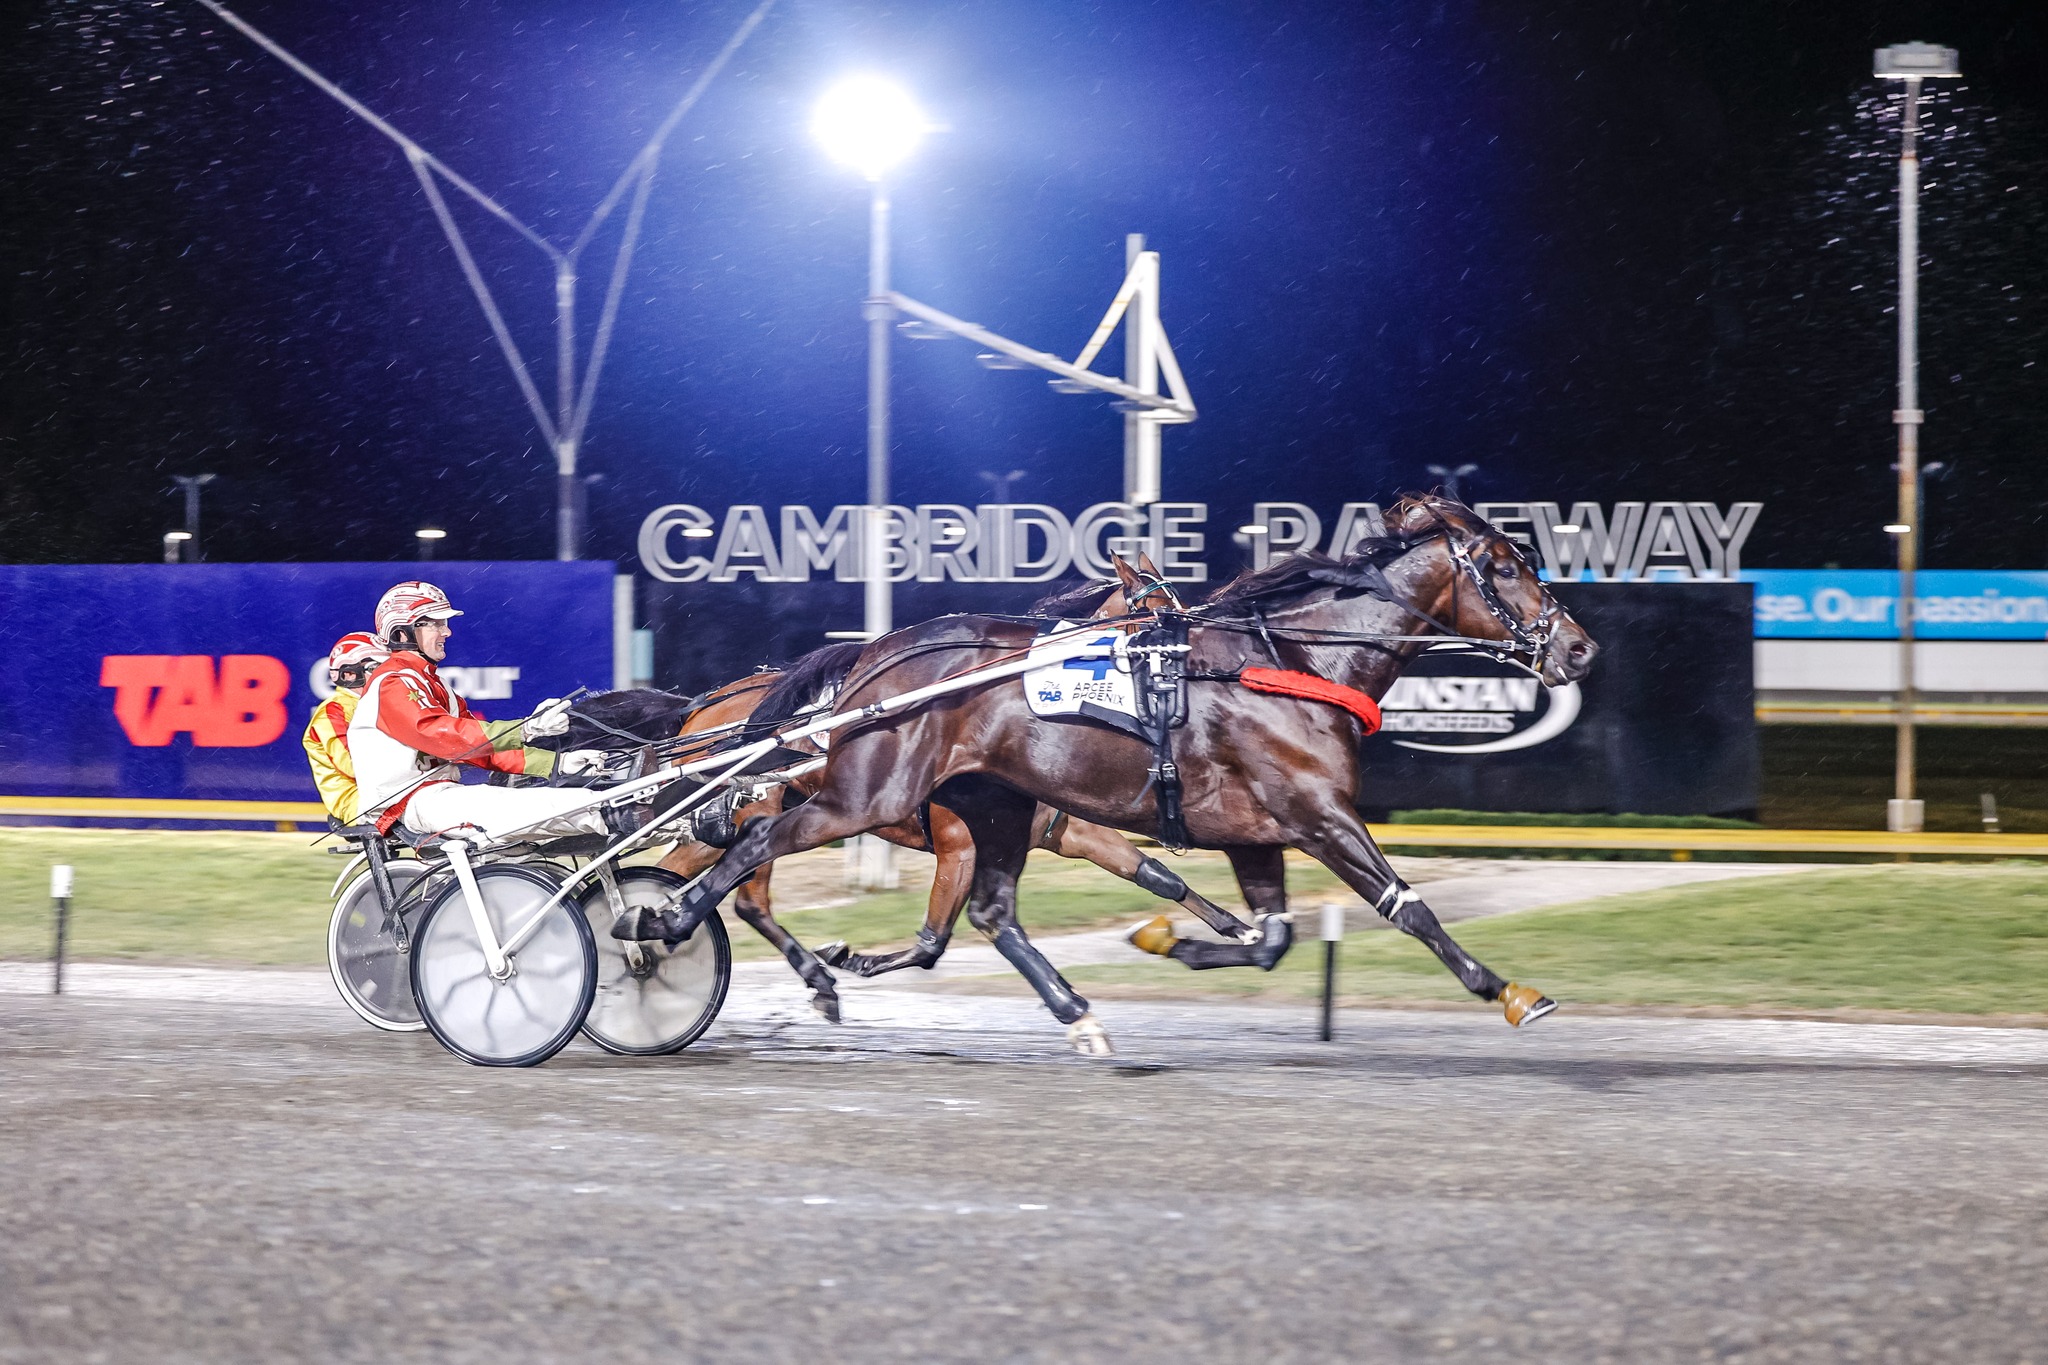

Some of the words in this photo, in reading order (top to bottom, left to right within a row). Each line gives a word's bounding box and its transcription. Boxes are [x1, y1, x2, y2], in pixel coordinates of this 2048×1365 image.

[637, 502, 1208, 584] CAMBRIDGE
[1253, 501, 1764, 584] RAEWAY
[1037, 690, 1062, 703] TAB
[1071, 691, 1126, 706] PHOENIX
[1073, 682, 1114, 693] ARCEE
[1378, 676, 1539, 712] UNSTAN
[99, 654, 291, 748] TAB
